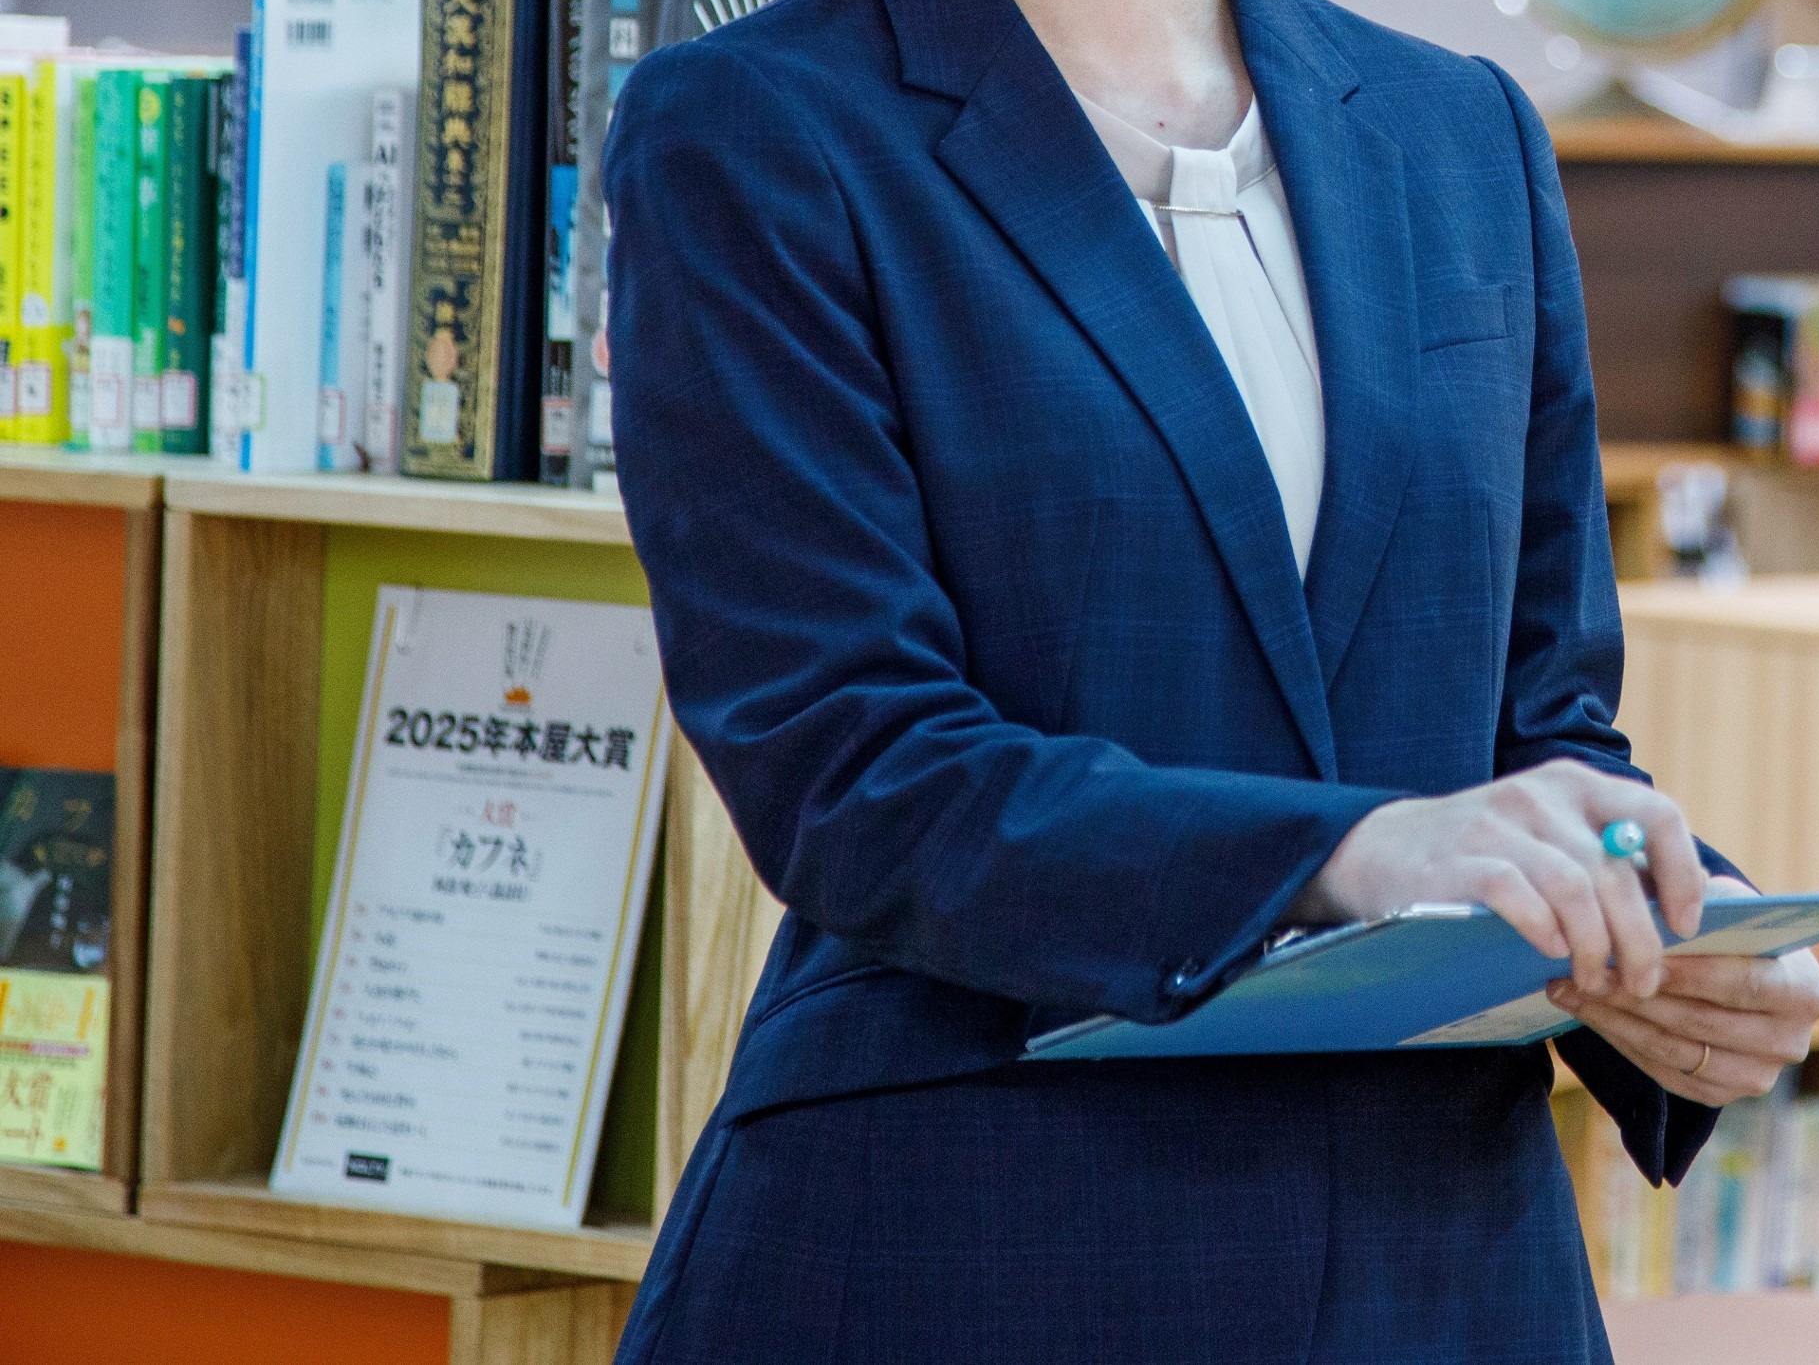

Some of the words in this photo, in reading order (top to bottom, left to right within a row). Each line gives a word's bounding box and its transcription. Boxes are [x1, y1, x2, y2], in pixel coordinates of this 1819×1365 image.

[385, 706, 635, 773] 2025年本屋大賞
